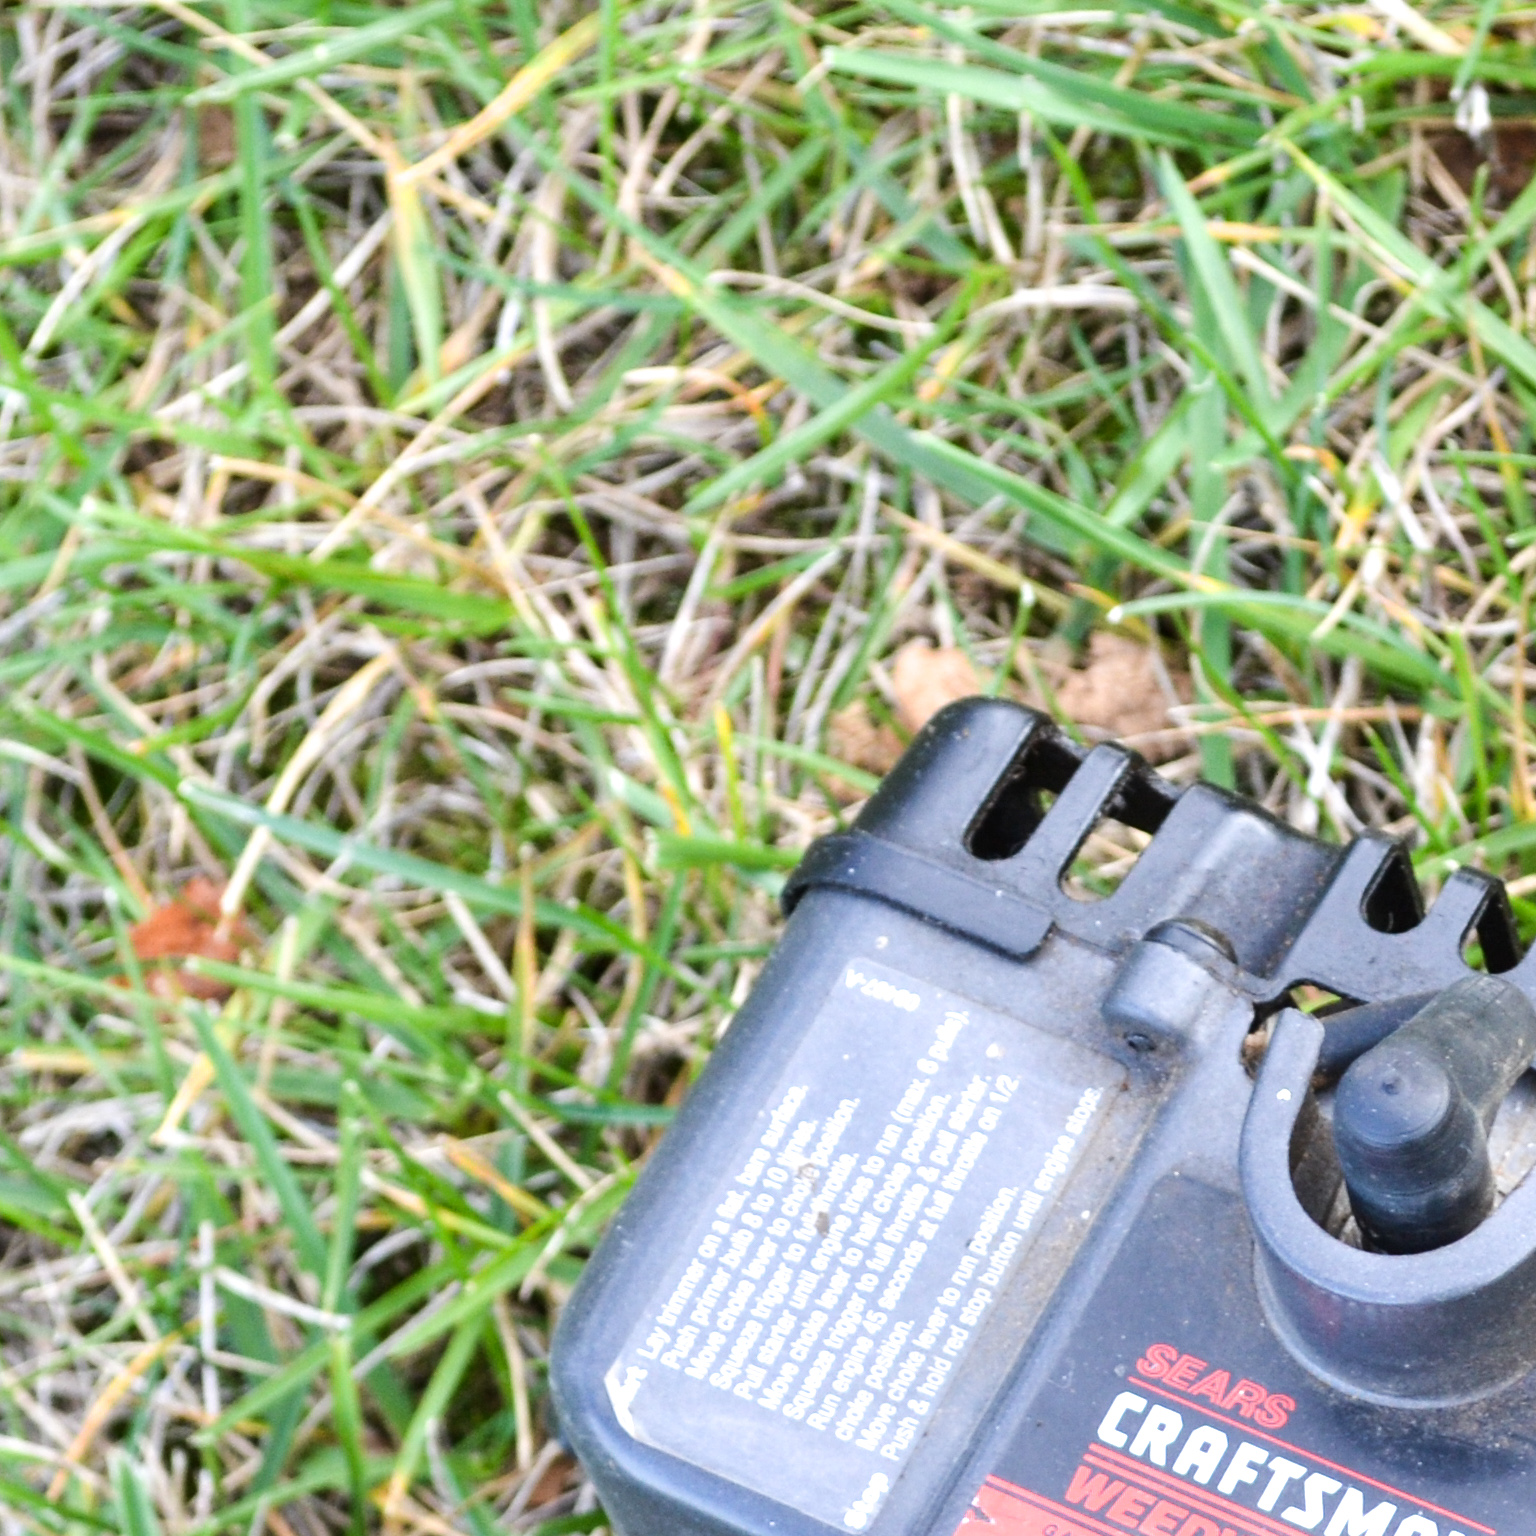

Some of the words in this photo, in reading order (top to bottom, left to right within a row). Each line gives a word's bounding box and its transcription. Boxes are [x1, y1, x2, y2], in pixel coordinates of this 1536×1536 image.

[637, 1327, 669, 1358] Lay
[657, 1259, 705, 1325] trimmer
[736, 1149, 769, 1185] bare
[661, 1326, 698, 1368] Push
[691, 1267, 729, 1324] primer
[719, 1230, 753, 1267] bulb
[685, 1333, 724, 1378] Move
[717, 1281, 754, 1329] choke
[742, 1237, 776, 1278] lever
[710, 1321, 761, 1388] Squeeze
[751, 1263, 792, 1317] trigger
[734, 1365, 765, 1398] Pull
[758, 1310, 795, 1363] starter
[812, 1216, 850, 1269] engine
[840, 1177, 872, 1212] tries
[876, 1125, 901, 1153] run
[758, 1363, 797, 1409] Move
[790, 1311, 826, 1360] choke
[815, 1267, 849, 1307] lever
[851, 1212, 880, 1244] half
[874, 1163, 909, 1211] choke
[783, 1351, 834, 1418] Squeeze
[824, 1293, 864, 1347] trigger
[866, 1243, 893, 1270] full
[883, 1184, 927, 1241] throttle
[930, 1130, 957, 1165] pull
[807, 1395, 839, 1429] Run
[833, 1337, 872, 1391] engine
[879, 1241, 925, 1308] seconds
[925, 1191, 952, 1218] full
[942, 1132, 986, 1189] throttle
[856, 1404, 895, 1449] Move
[888, 1352, 924, 1400] choke
[913, 1307, 946, 1347] lever
[952, 1256, 977, 1284] run
[881, 1418, 918, 1459] Push
[917, 1357, 950, 1395] hold
[944, 1326, 967, 1354] red
[960, 1289, 990, 1324] stop
[979, 1232, 1020, 1284] button
[1013, 1191, 1042, 1228] until
[1035, 1136, 1073, 1189] engine
[836, 1391, 872, 1439] choke
[1136, 1343, 1295, 1428] SEARS
